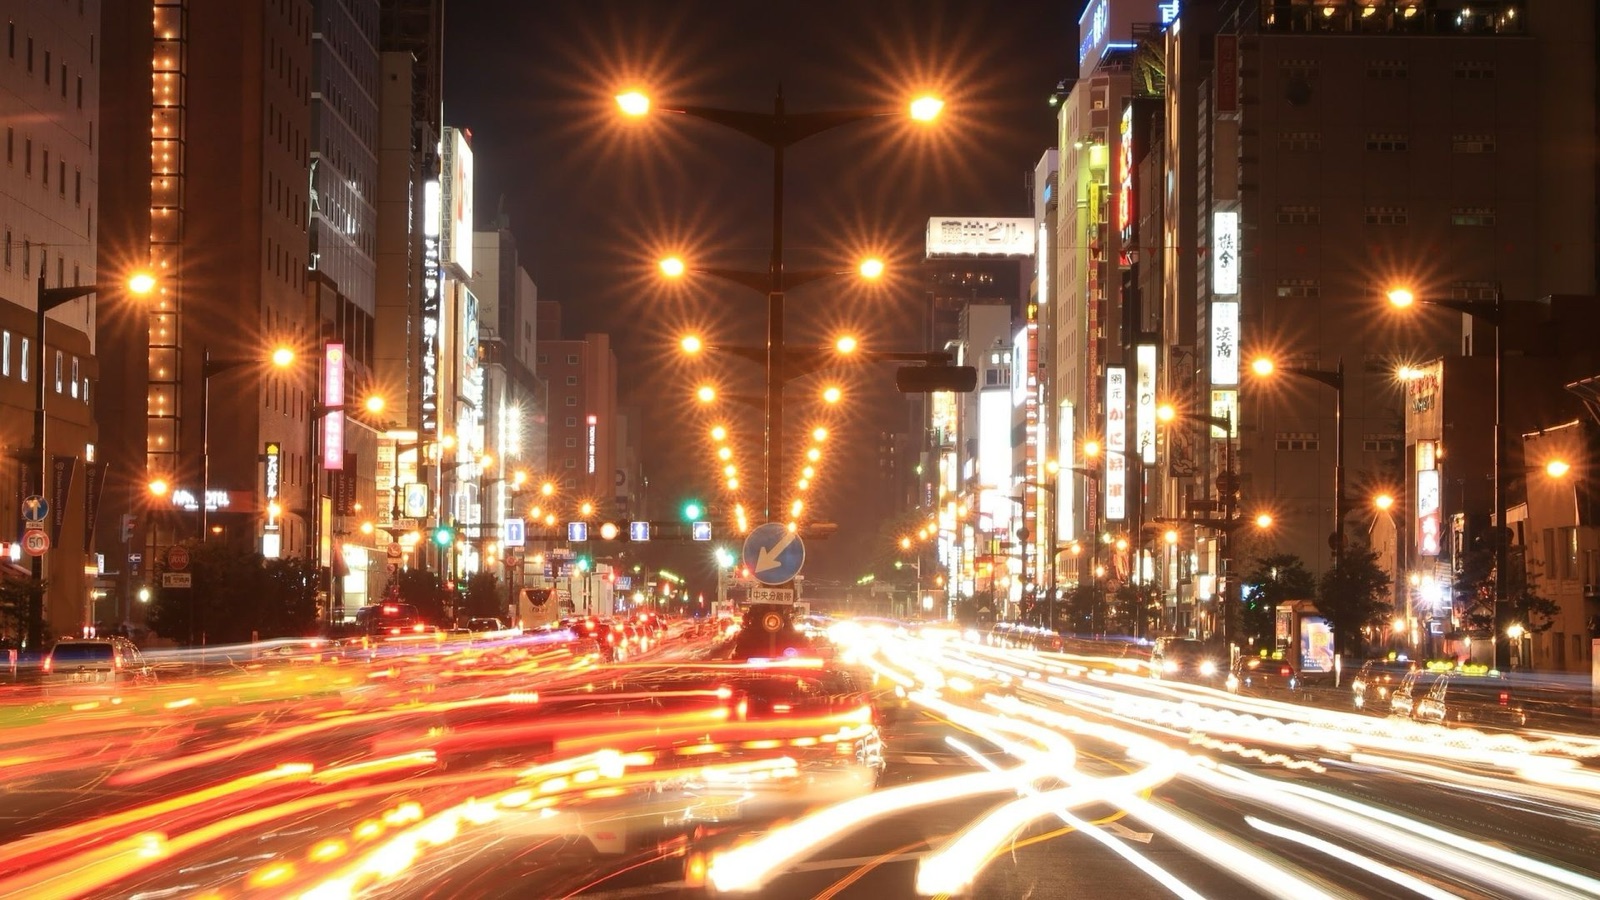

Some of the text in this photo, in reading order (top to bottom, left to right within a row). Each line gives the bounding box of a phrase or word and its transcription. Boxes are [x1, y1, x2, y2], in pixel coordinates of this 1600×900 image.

[941, 220, 1023, 244] 藤井ビル
[1110, 373, 1122, 399] 網元
[1108, 407, 1124, 497] かに将軍
[267, 455, 278, 498] アパホテル
[205, 491, 230, 507] OTEL
[346, 477, 354, 513] Mercure
[28, 537, 43, 548] 50
[753, 591, 792, 601] 中央分離帯
